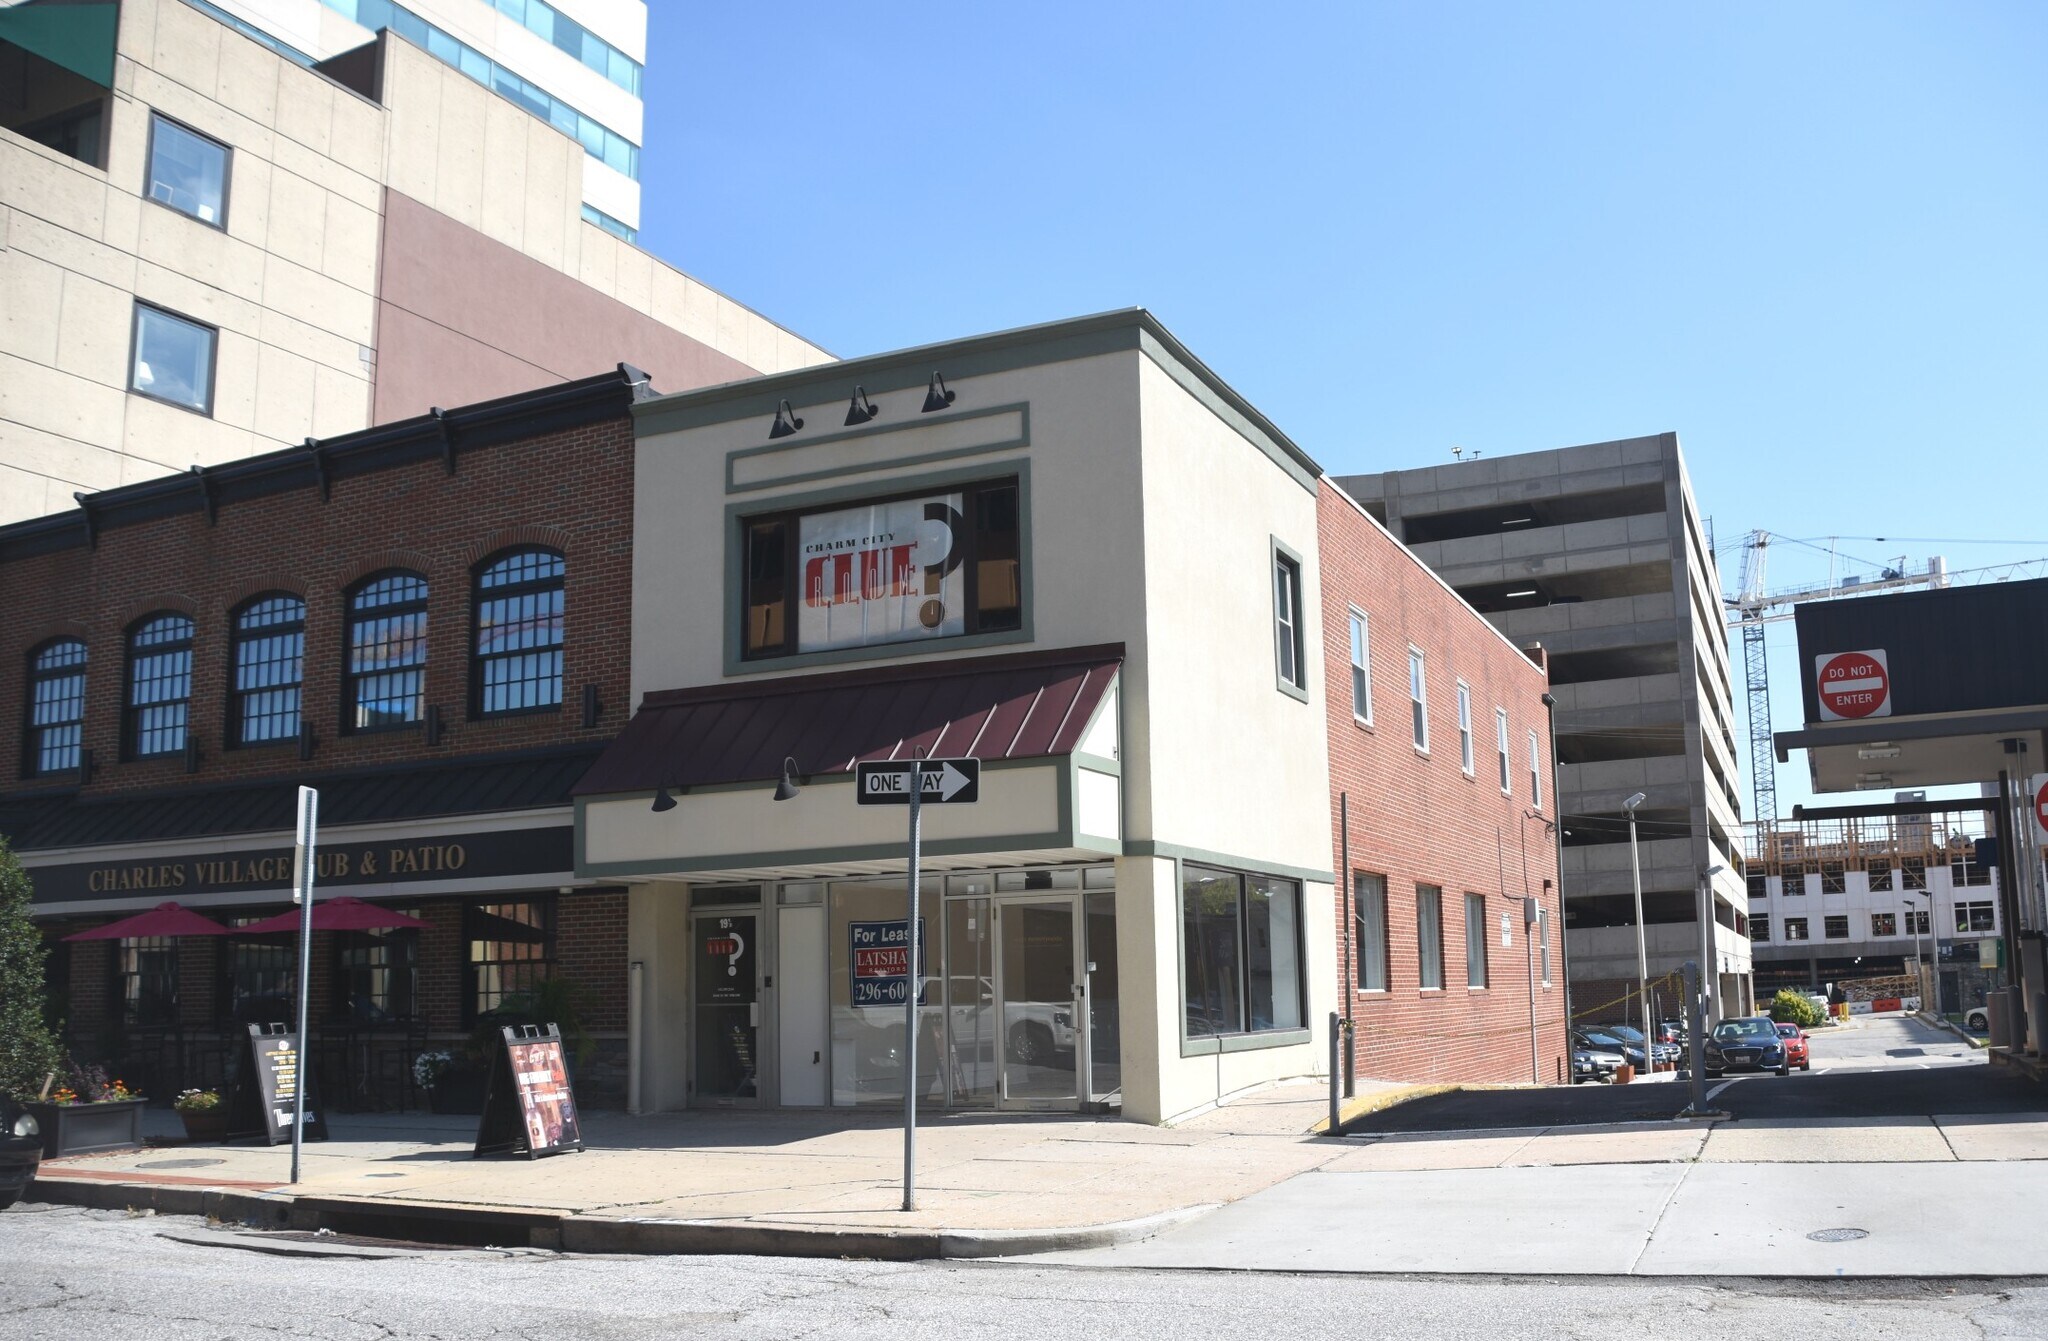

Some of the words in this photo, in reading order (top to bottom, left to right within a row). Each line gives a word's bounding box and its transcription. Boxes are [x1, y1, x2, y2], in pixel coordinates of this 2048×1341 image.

[806, 538, 856, 553] CHARM
[862, 533, 896, 546] CITY
[805, 541, 918, 608] CLUE
[814, 564, 908, 608] ROOM
[1828, 667, 1845, 679] DO
[1850, 664, 1873, 677] NOT
[1836, 692, 1873, 706] ENTER
[870, 774, 902, 792] ONE
[919, 773, 944, 790] AY
[88, 863, 186, 892] CHARLES
[195, 856, 290, 885] VILLAGE
[317, 852, 350, 878] UB
[360, 850, 377, 876] &
[389, 844, 466, 874] PATIO
[854, 927, 876, 943] For
[881, 927, 913, 943] Leas
[857, 951, 908, 966] LATSHA
